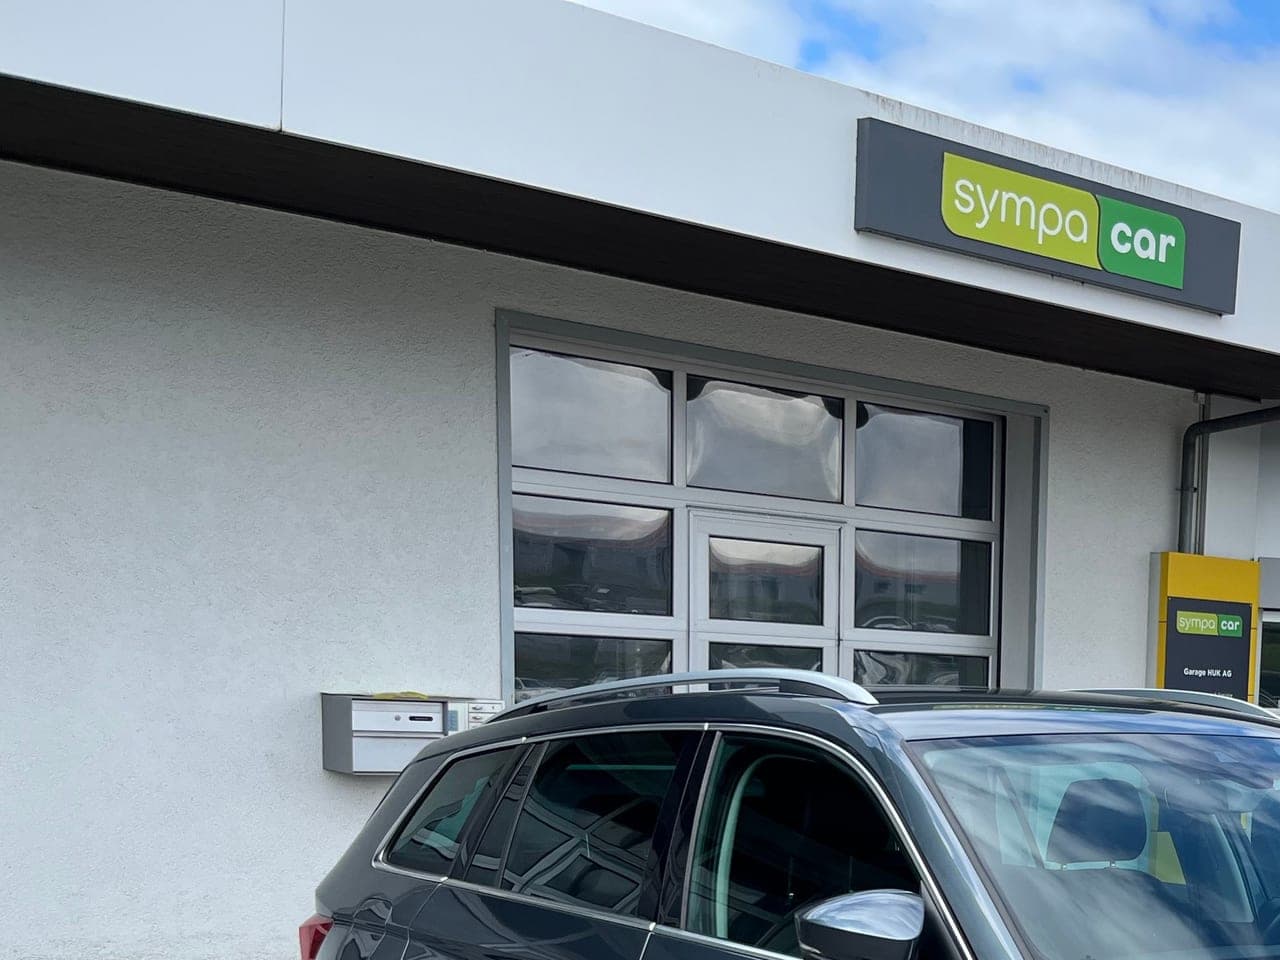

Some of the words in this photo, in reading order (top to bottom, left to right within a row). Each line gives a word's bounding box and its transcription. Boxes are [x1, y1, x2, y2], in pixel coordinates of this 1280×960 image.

[954, 179, 1088, 245] sympa
[1110, 222, 1176, 263] car
[1179, 617, 1216, 632] sympa
[1221, 620, 1240, 631] car
[1183, 667, 1206, 678] Garage
[1207, 669, 1221, 677] HUK
[1222, 670, 1232, 678] AG
